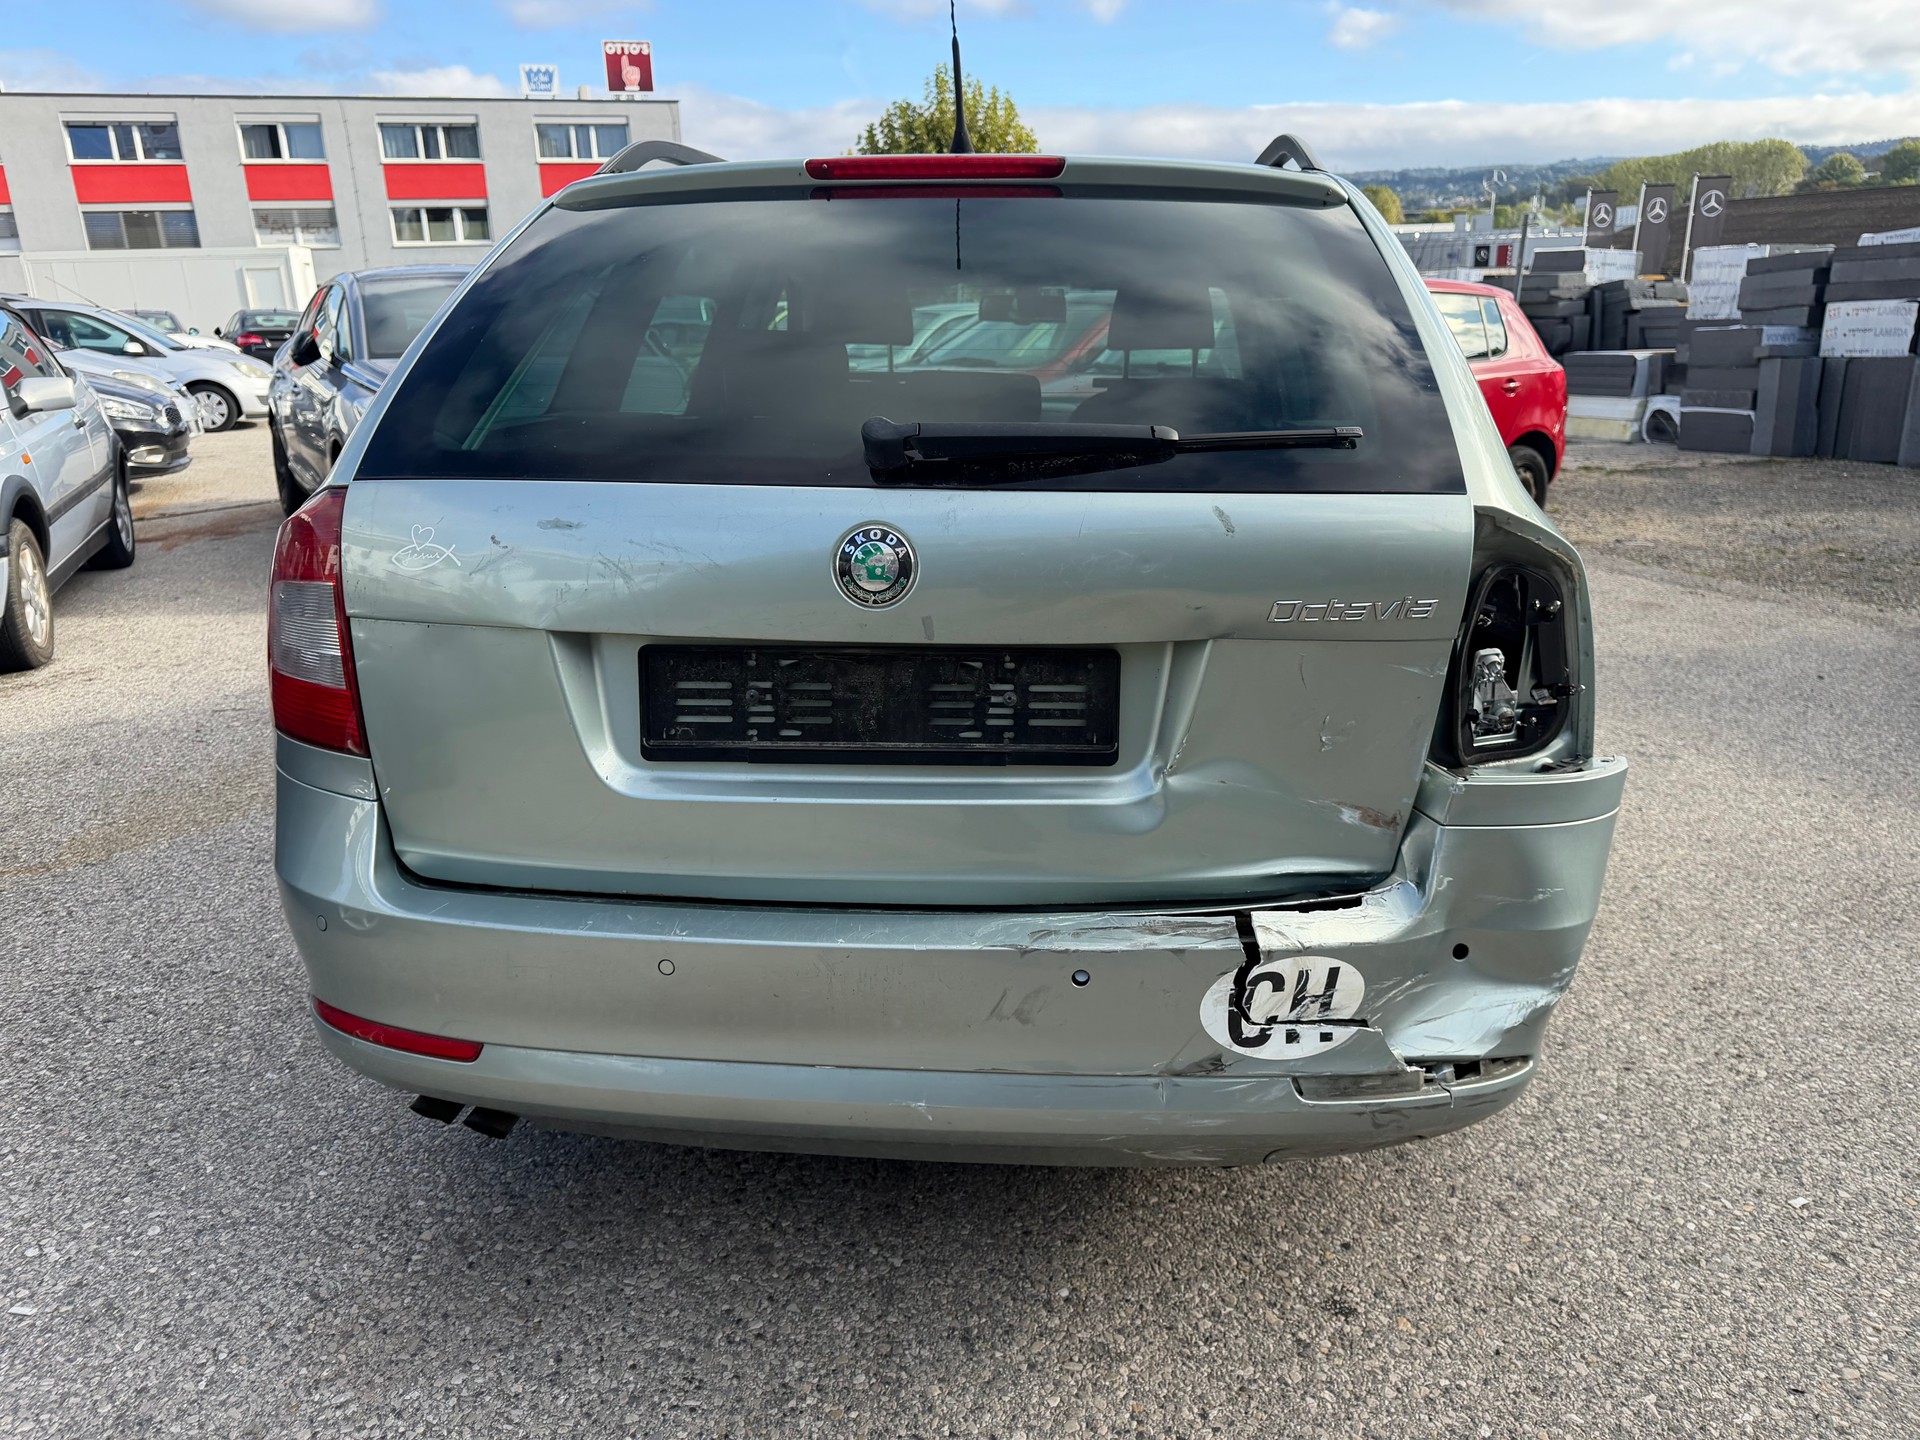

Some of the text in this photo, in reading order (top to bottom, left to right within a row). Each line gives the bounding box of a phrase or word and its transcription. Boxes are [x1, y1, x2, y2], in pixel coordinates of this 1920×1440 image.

[605, 43, 650, 55] OTTO'S
[400, 550, 440, 567] Jesus
[1267, 596, 1440, 623] Octavia
[1227, 966, 1341, 1049] CH
